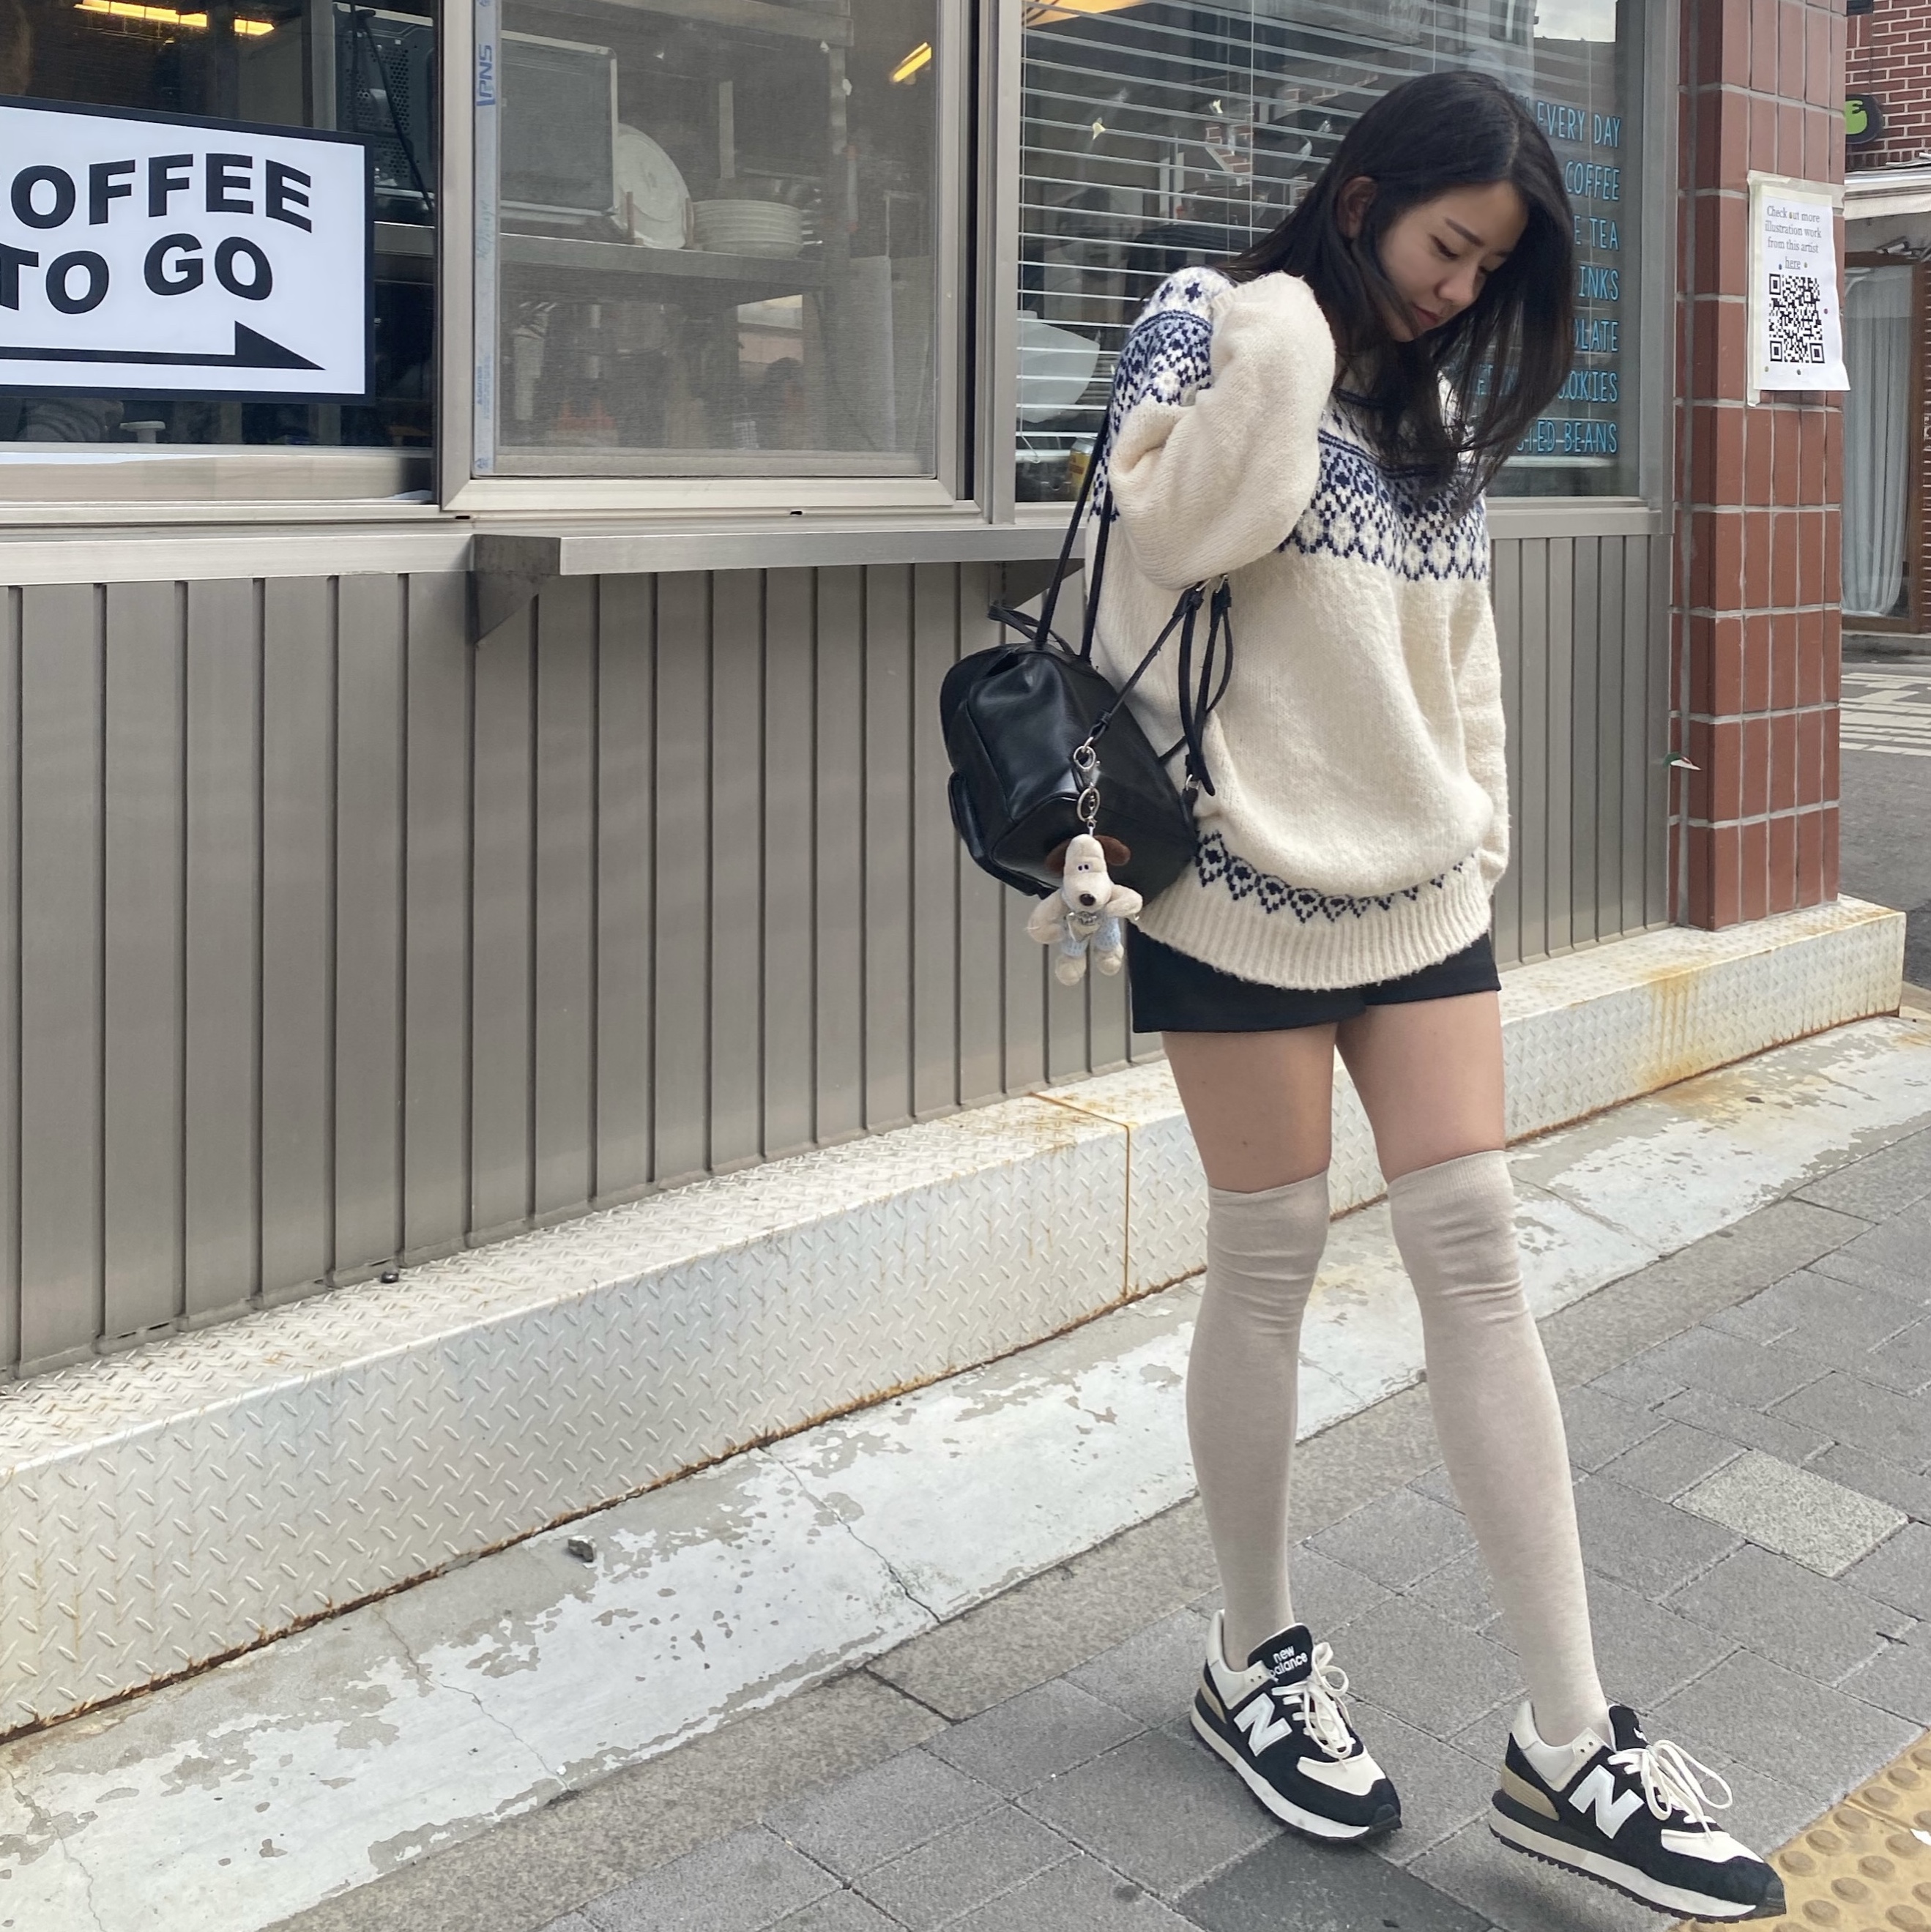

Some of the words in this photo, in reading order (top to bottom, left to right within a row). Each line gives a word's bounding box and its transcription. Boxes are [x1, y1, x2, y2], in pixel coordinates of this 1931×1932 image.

[1537, 100, 1585, 142] EVERY
[1593, 113, 1621, 148] DAY
[1564, 160, 1621, 201] COFFEE
[1765, 220, 1803, 236] illustration
[1804, 227, 1822, 239] work
[1767, 205, 1787, 219] Check
[1789, 211, 1799, 220] ut
[1801, 213, 1820, 223] more
[1589, 217, 1620, 251] TEA
[1768, 236, 1785, 249] from
[1786, 239, 1800, 251] this
[1801, 242, 1819, 253] artist
[0, 242, 110, 315] TO
[144, 233, 274, 301] GO
[1785, 256, 1801, 270] here
[1564, 421, 1618, 453] BEANS
[1273, 1645, 1295, 1663] new
[1233, 1693, 1293, 1757] N
[1568, 1764, 1645, 1839] N
